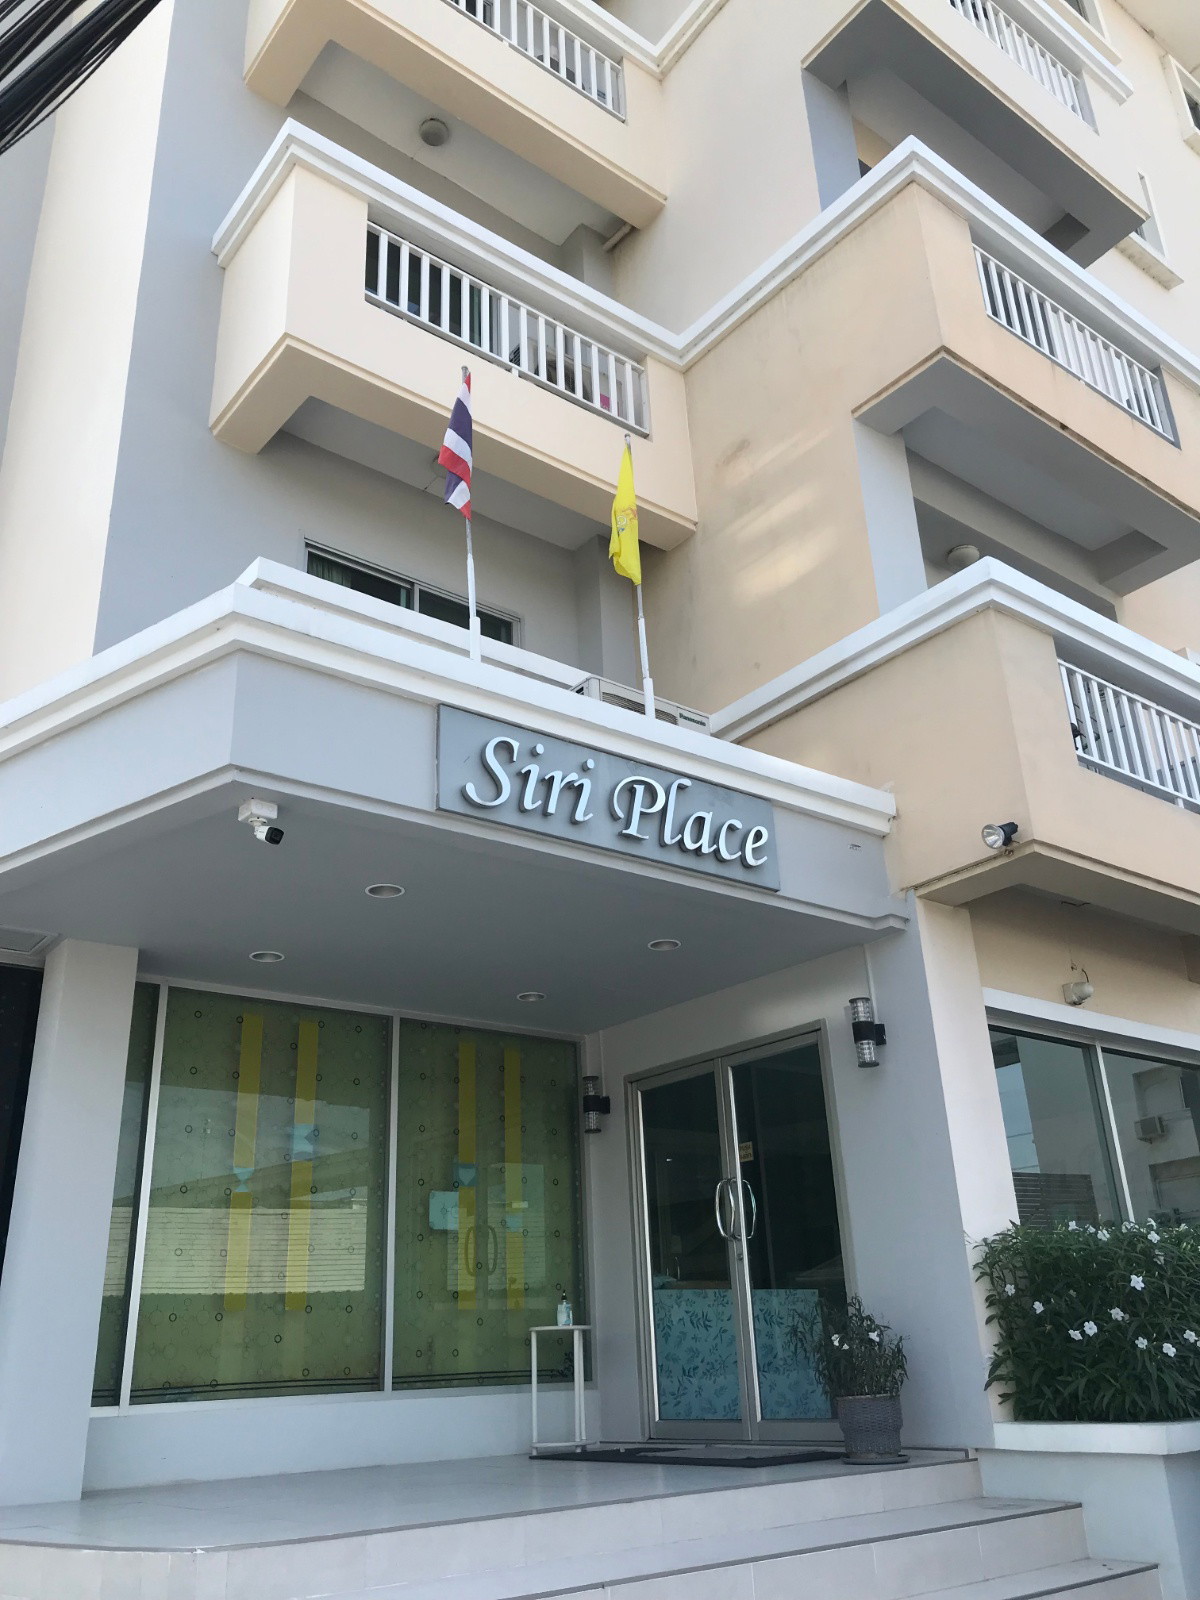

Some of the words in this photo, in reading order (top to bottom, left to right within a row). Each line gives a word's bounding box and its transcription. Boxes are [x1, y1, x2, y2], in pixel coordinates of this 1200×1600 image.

[678, 712, 707, 727] Panasonic
[462, 736, 595, 824] Siri
[610, 775, 769, 867] Place
